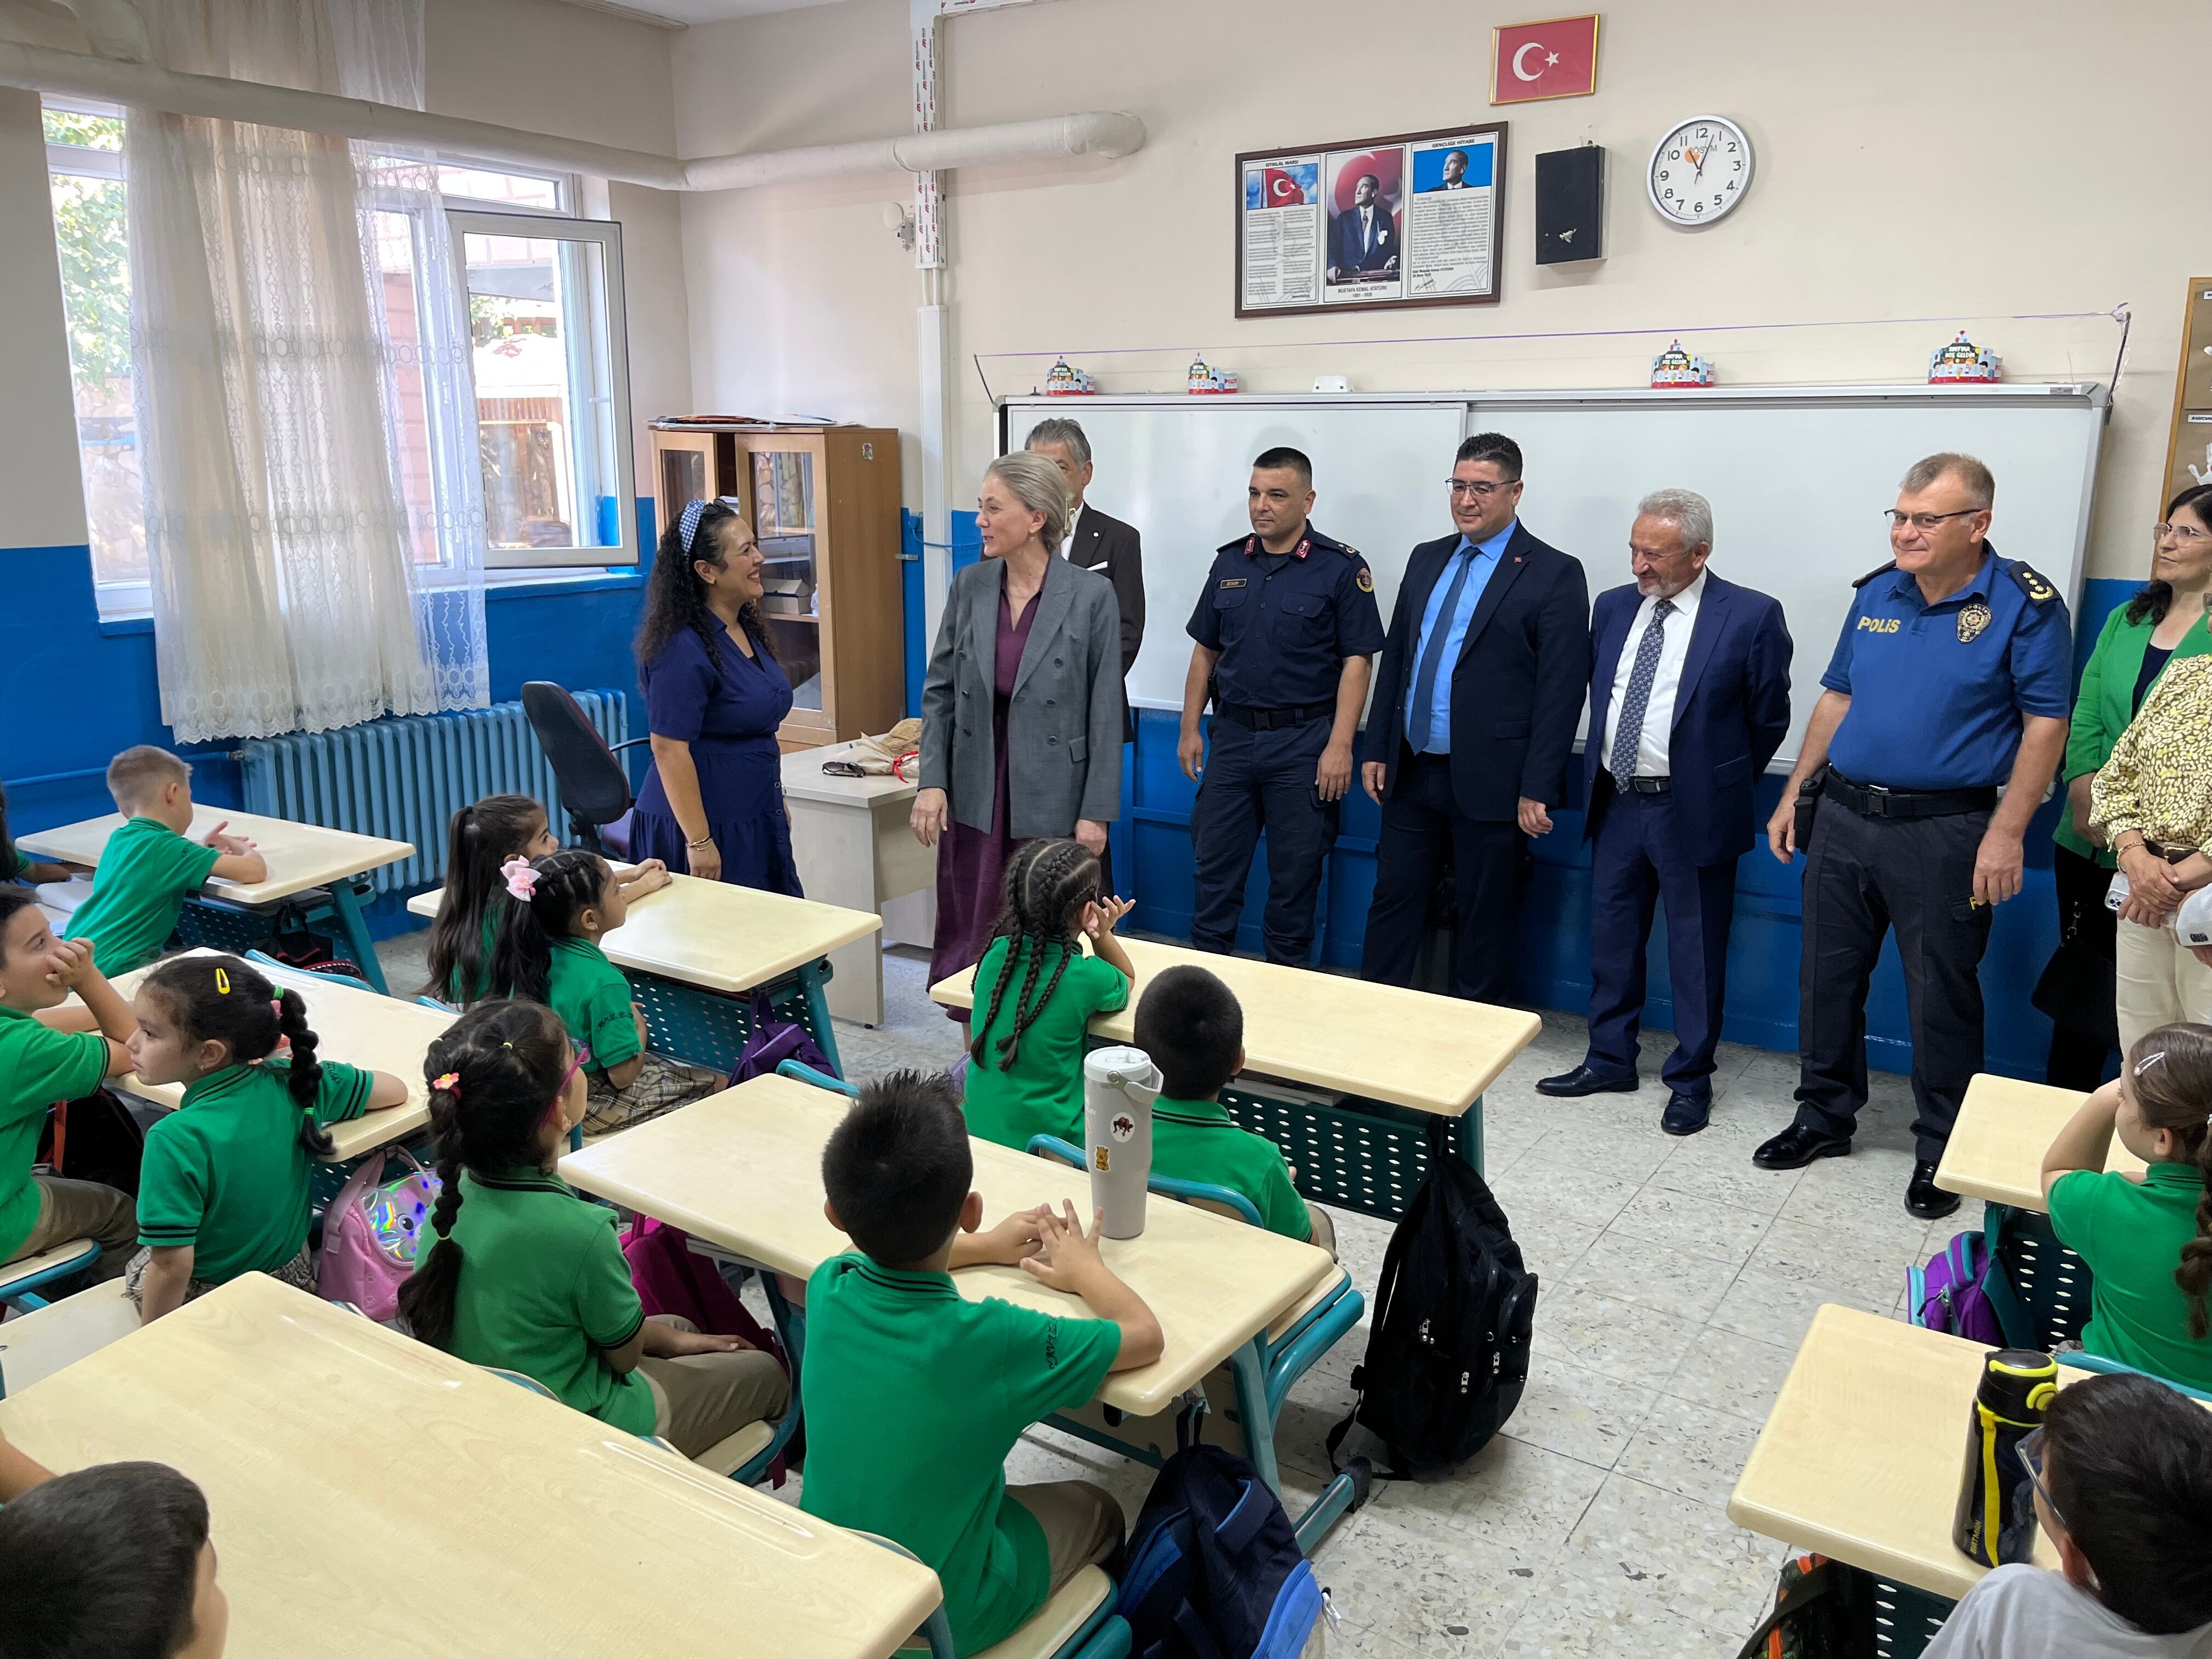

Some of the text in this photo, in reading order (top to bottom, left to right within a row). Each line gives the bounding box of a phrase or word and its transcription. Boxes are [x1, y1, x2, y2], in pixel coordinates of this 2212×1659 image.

[1696, 127, 1708, 139] 12
[1719, 131, 1722, 141] 1
[1680, 136, 1688, 147] 11
[1728, 142, 1736, 153] 2
[1668, 150, 1680, 161] 10
[1733, 160, 1741, 171] 3
[1660, 170, 1669, 181] 9
[1726, 180, 1735, 190] 4
[1664, 188, 1673, 199] 8
[1676, 199, 1685, 210] 7
[1714, 194, 1722, 205] 5
[1694, 202, 1703, 213] 6
[1970, 1519, 1982, 1554] BATMAN
